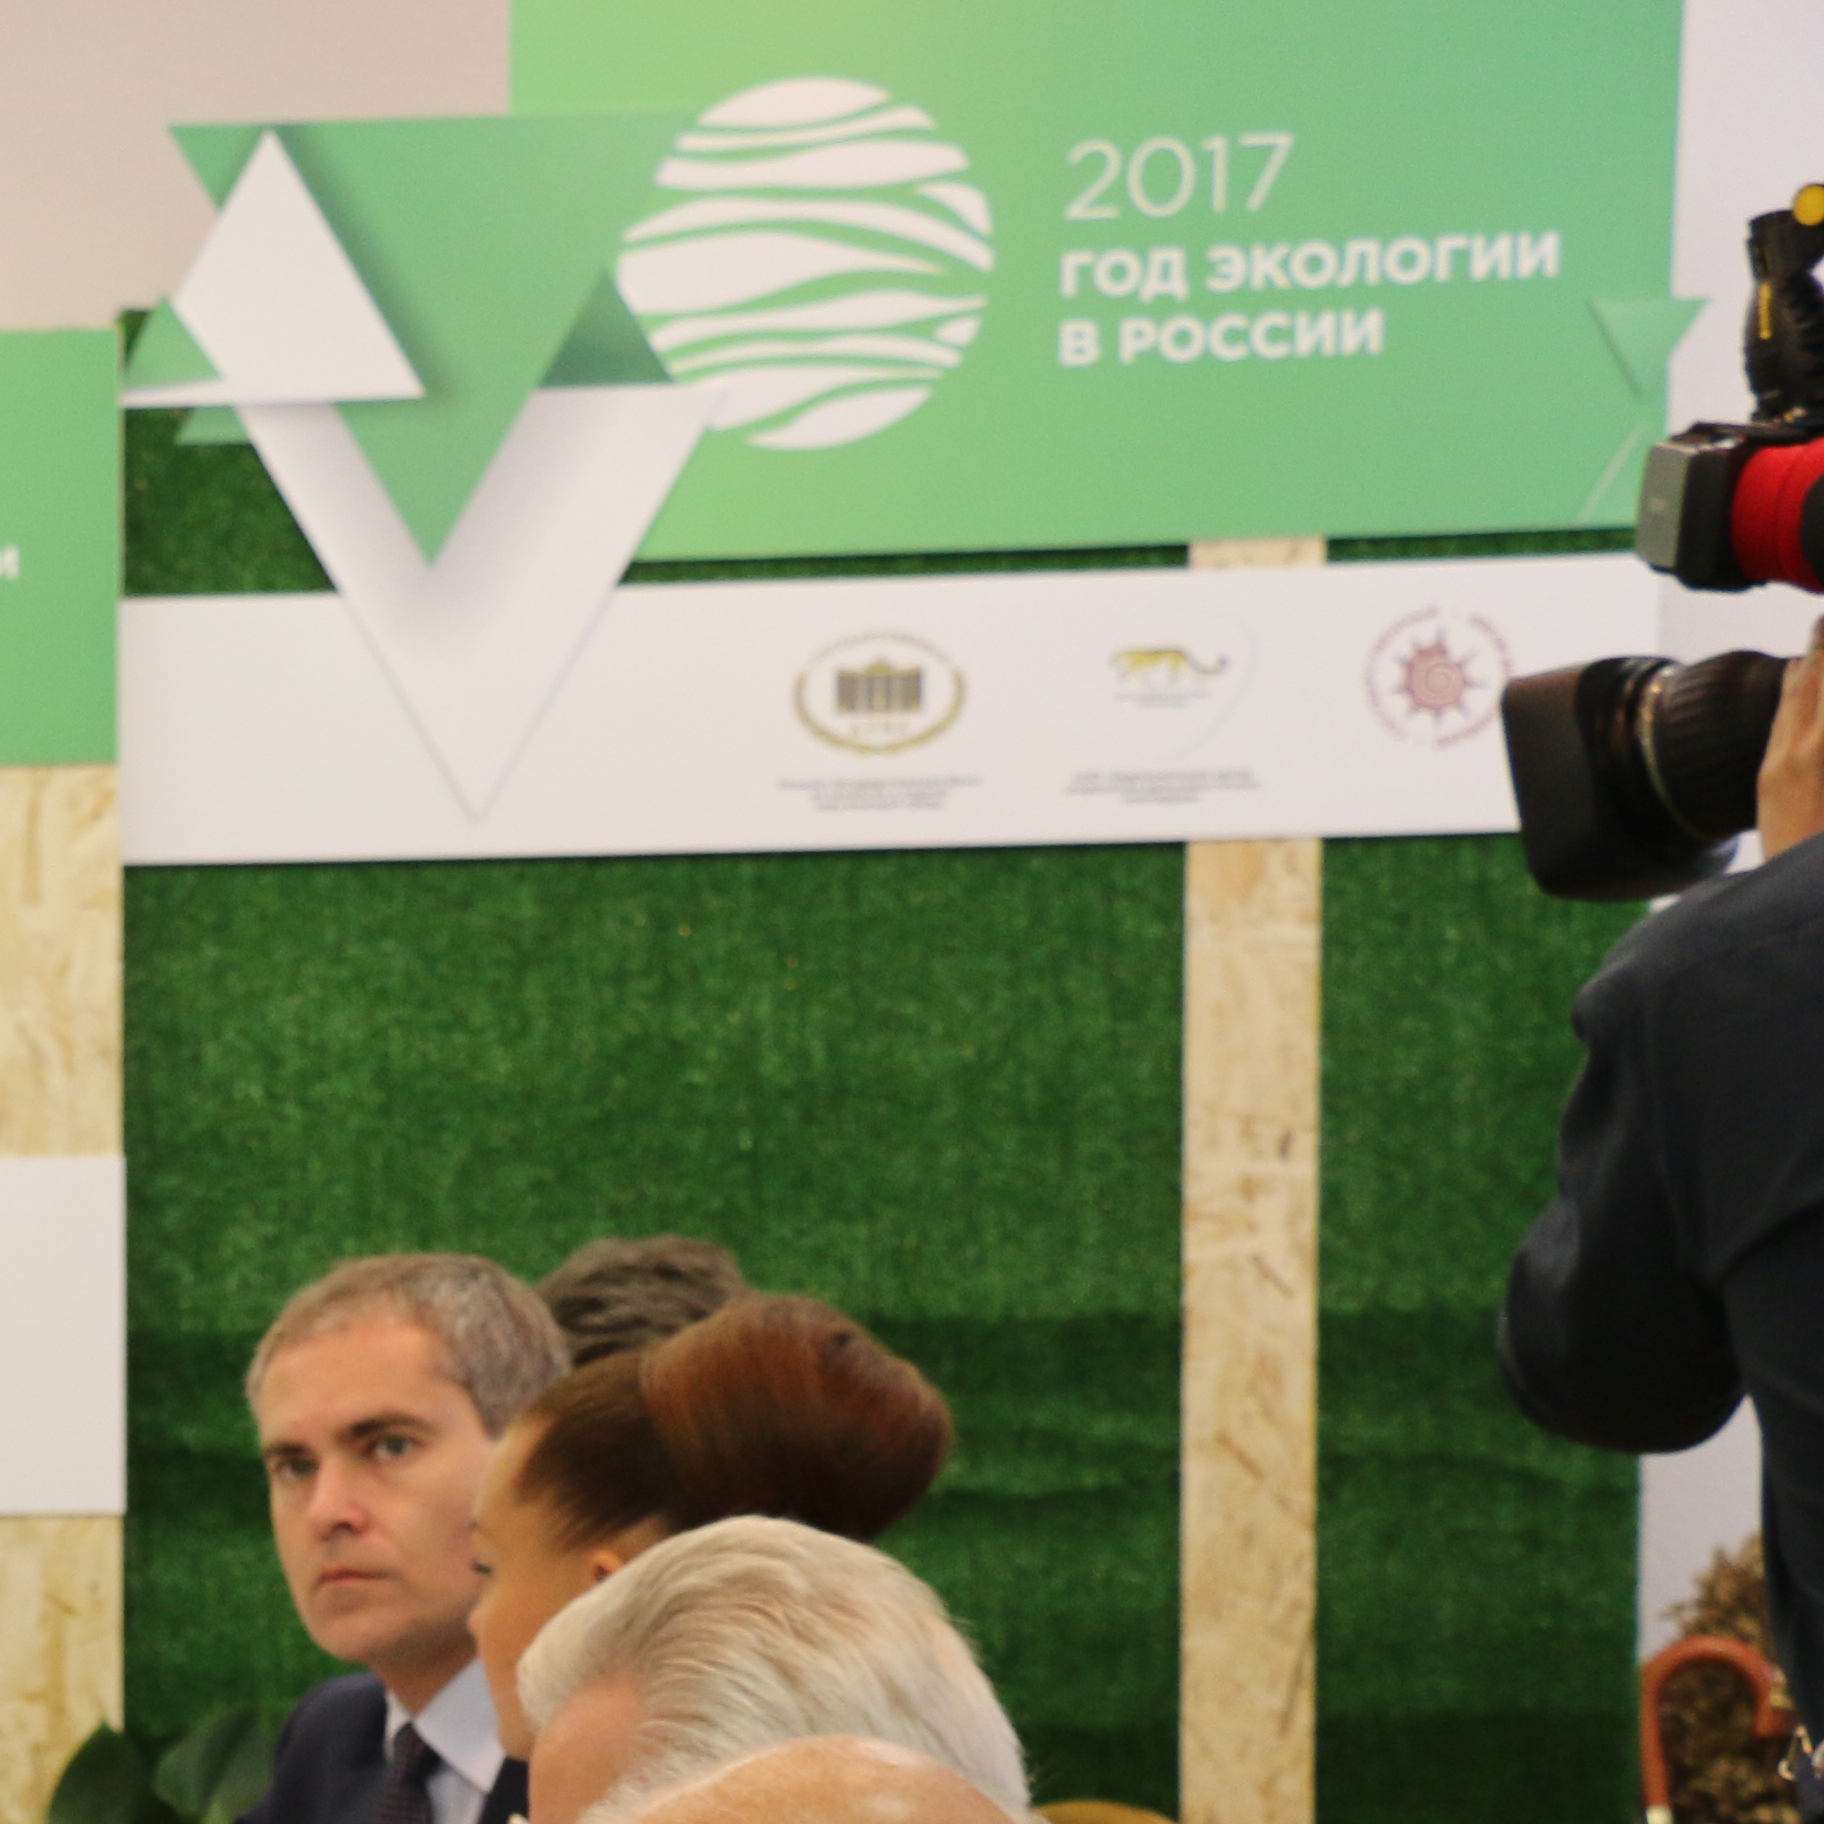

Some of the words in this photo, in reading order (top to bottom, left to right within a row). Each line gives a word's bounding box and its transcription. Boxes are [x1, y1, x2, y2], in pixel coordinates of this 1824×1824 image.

[1064, 131, 1295, 221] 2017
[1059, 247, 1190, 303] ГОД
[1206, 229, 1562, 293] ЭКОЛОГИИ
[1058, 319, 1101, 367] В
[1119, 307, 1384, 364] РОССИИ
